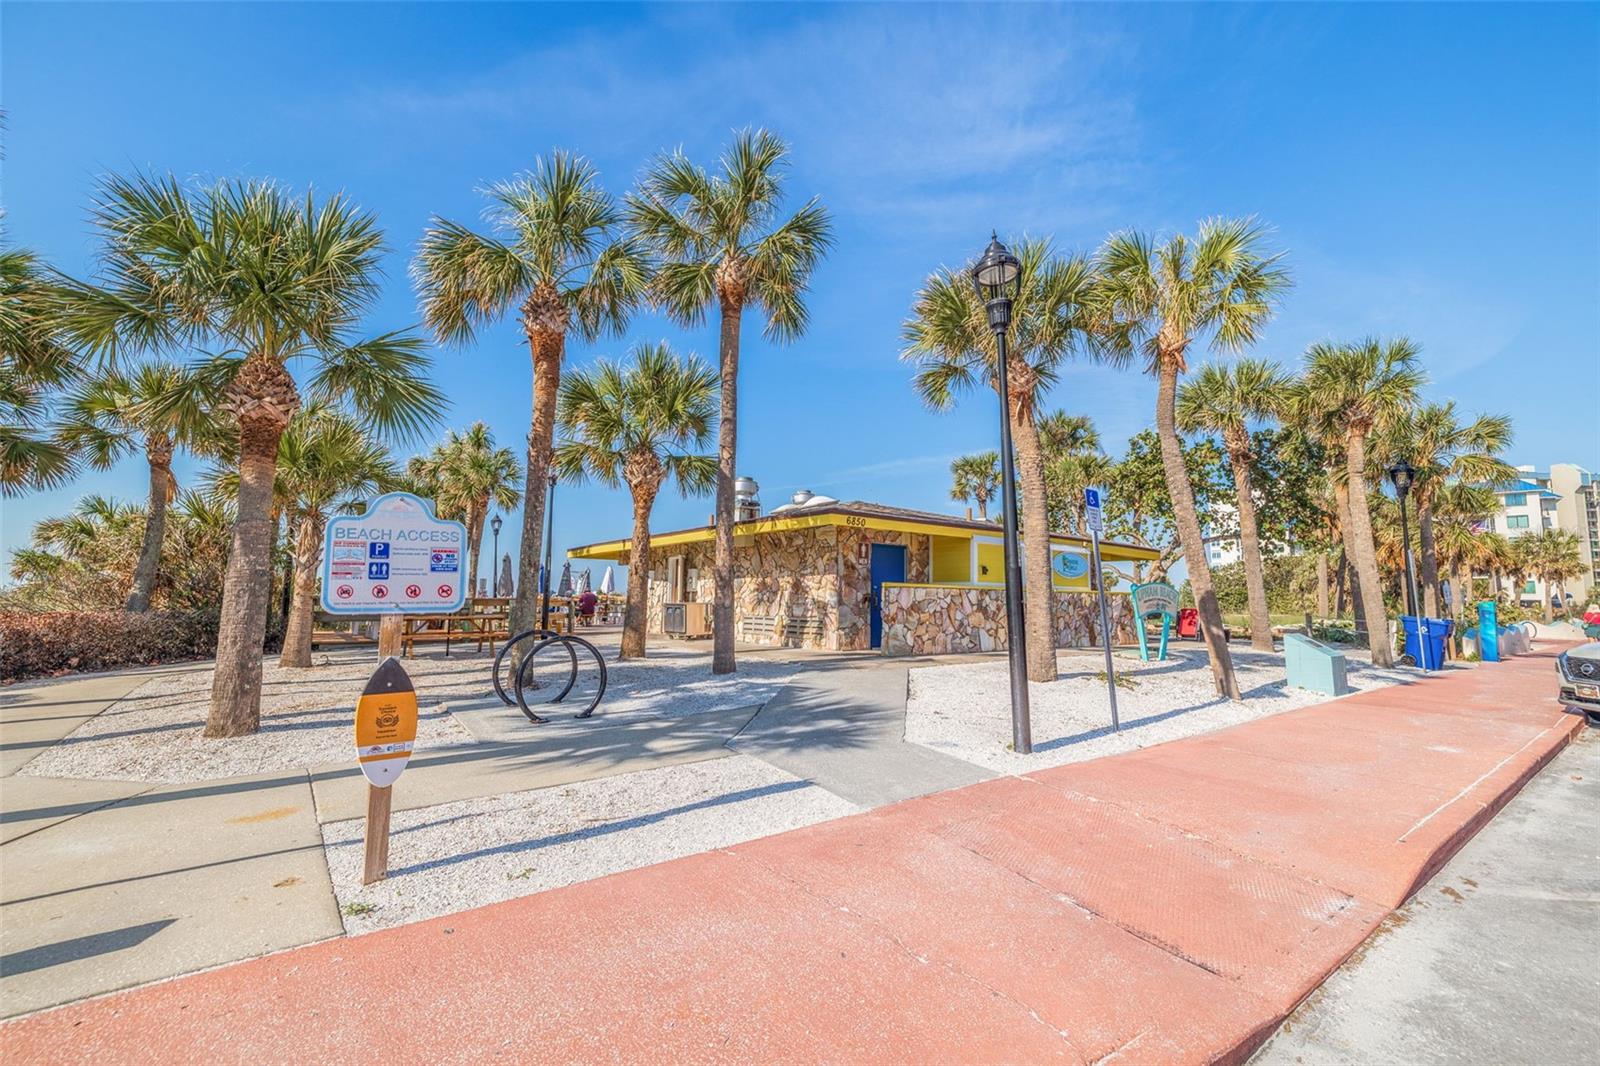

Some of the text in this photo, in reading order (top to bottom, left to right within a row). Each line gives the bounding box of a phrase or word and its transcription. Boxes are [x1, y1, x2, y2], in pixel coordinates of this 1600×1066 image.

[846, 516, 866, 527] 6850
[335, 528, 460, 542] BEACH ACCESS
[375, 543, 384, 555] P
